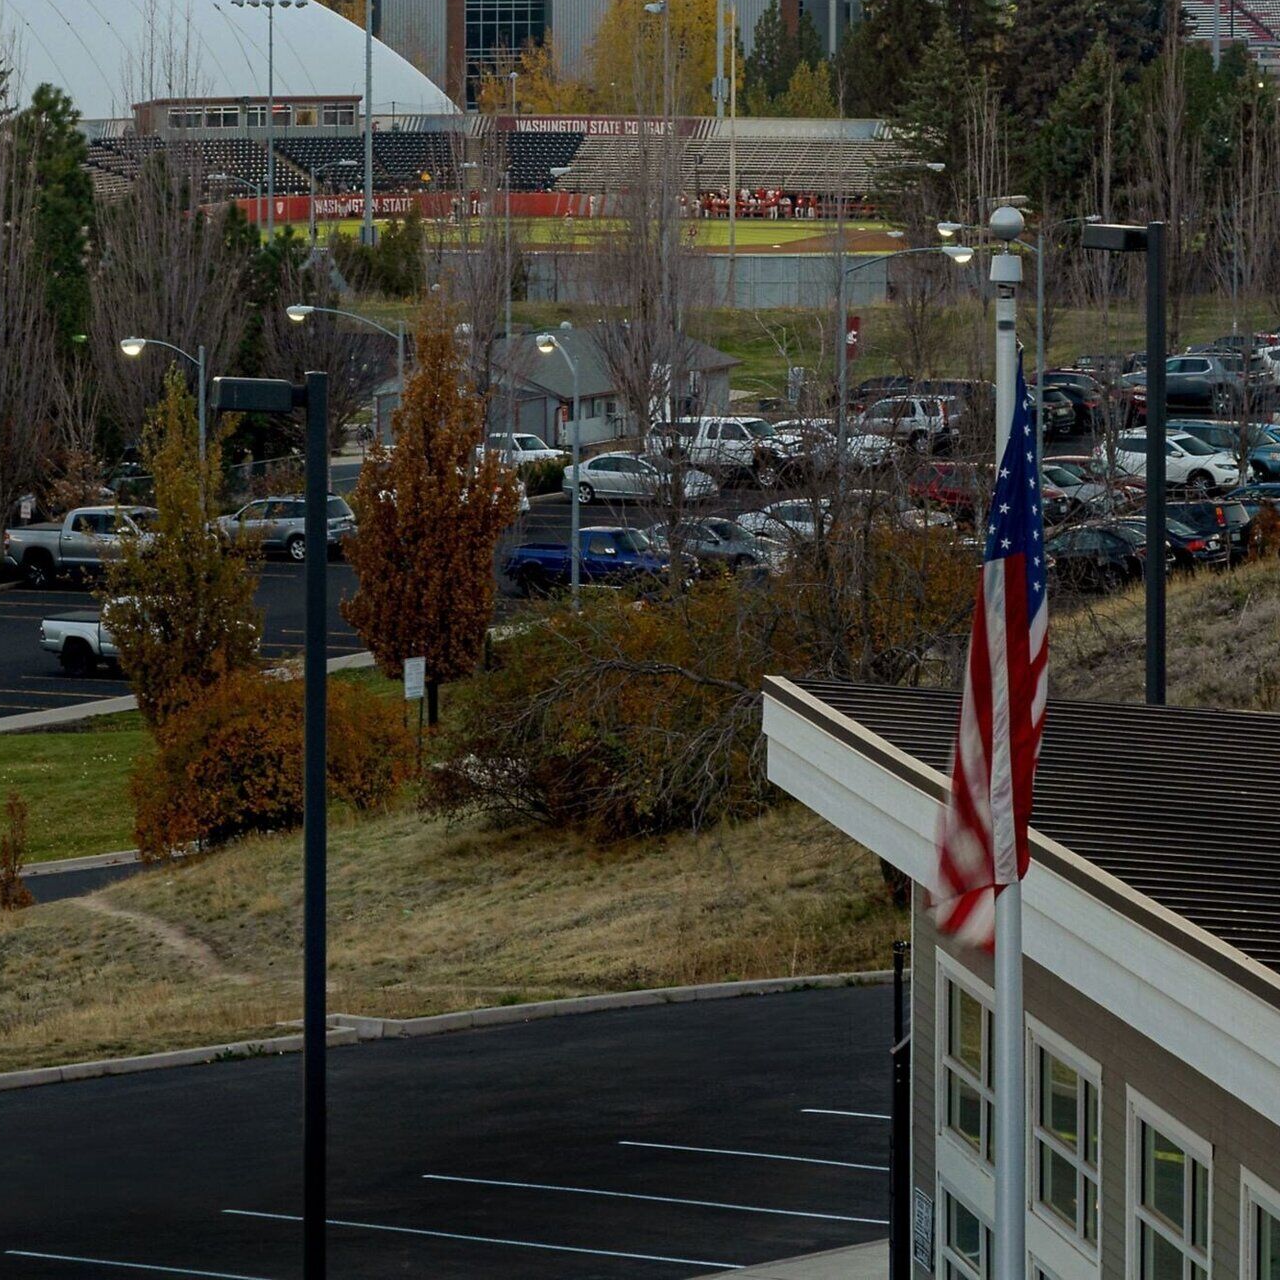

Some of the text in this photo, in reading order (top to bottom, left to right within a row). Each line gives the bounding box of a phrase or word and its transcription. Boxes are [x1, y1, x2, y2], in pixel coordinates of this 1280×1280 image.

[516, 120, 587, 132] WASHINGTON
[589, 121, 620, 134] STATE
[315, 199, 379, 214] WASHNGTN
